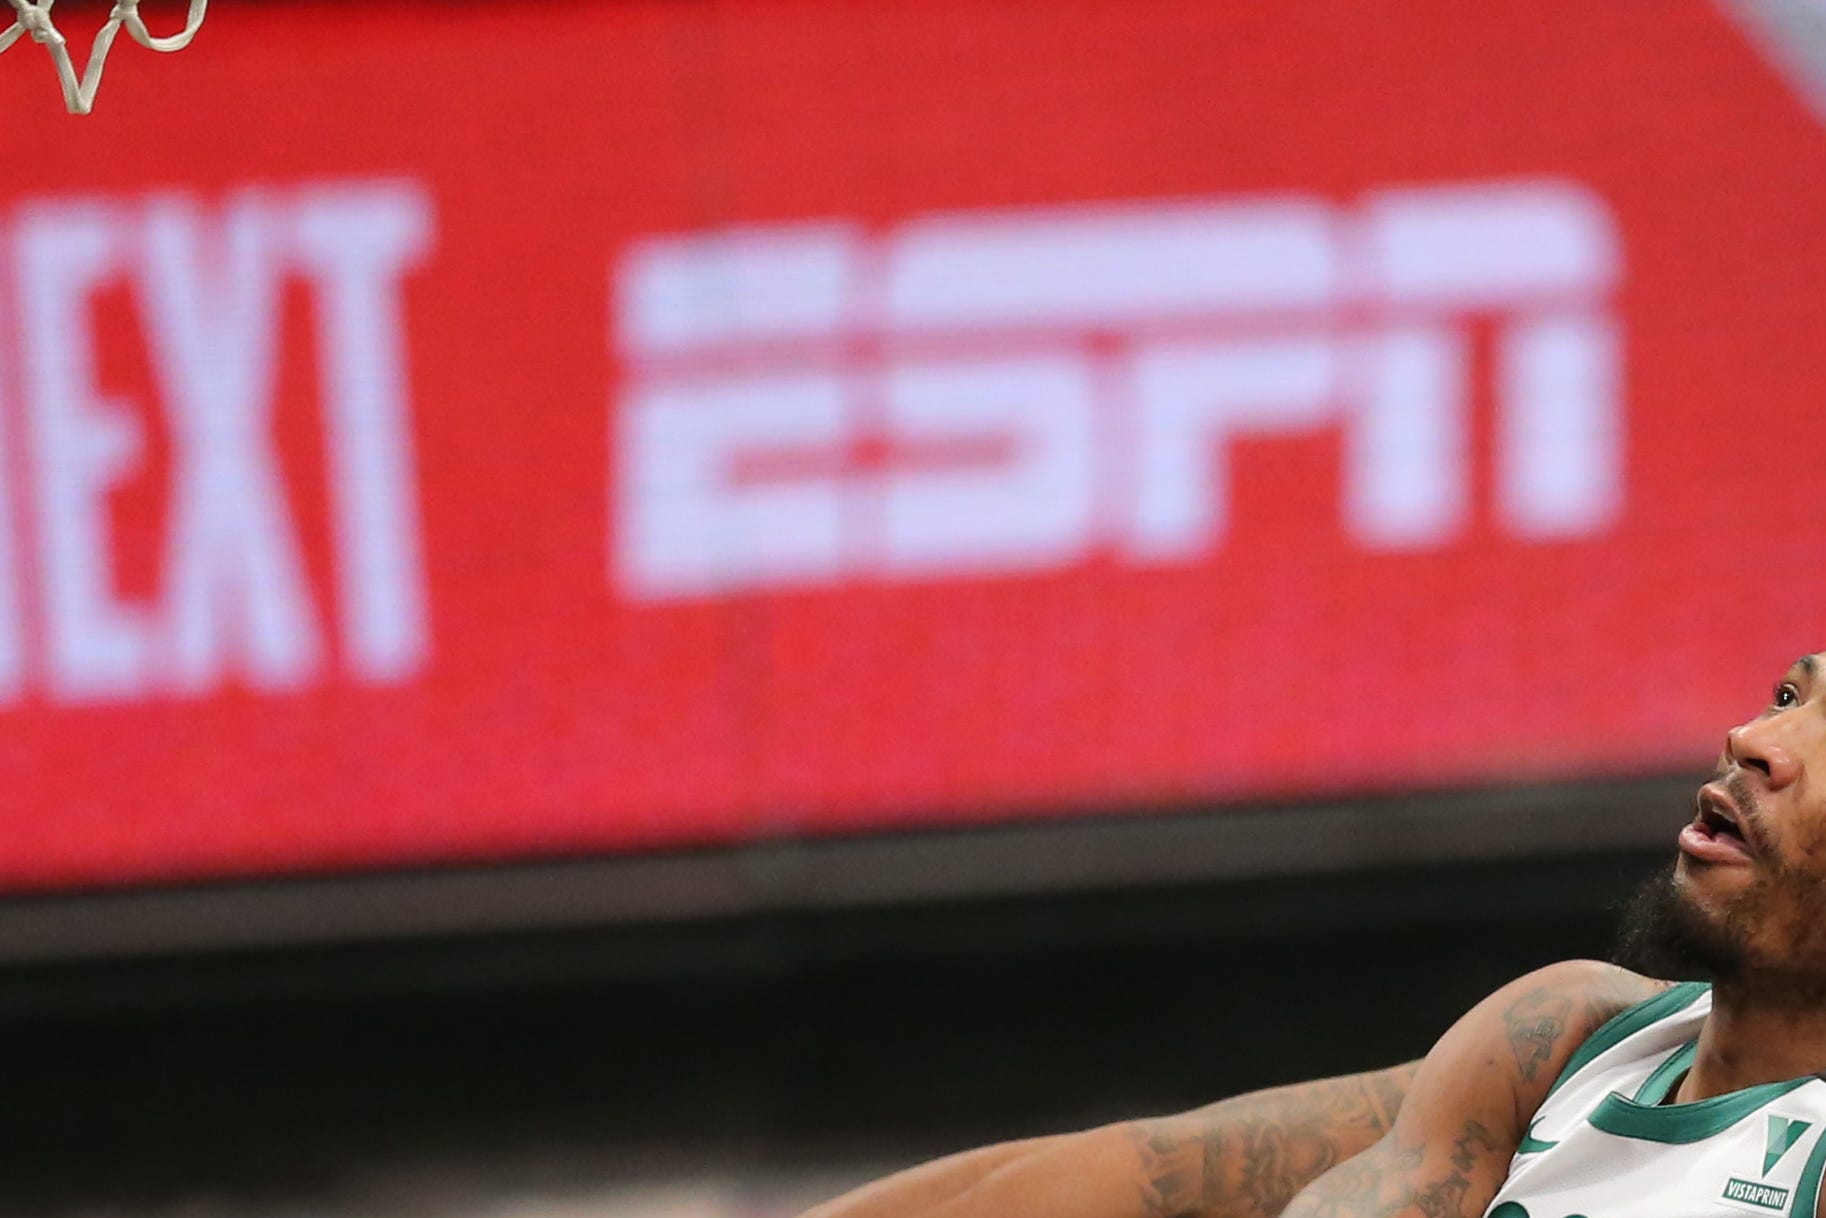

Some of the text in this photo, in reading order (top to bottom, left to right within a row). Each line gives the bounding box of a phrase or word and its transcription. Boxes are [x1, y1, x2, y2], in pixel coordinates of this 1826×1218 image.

[0, 177, 432, 702] EXT
[611, 178, 1625, 604] ESPN
[1726, 1179, 1788, 1209] VISTAPRINT
